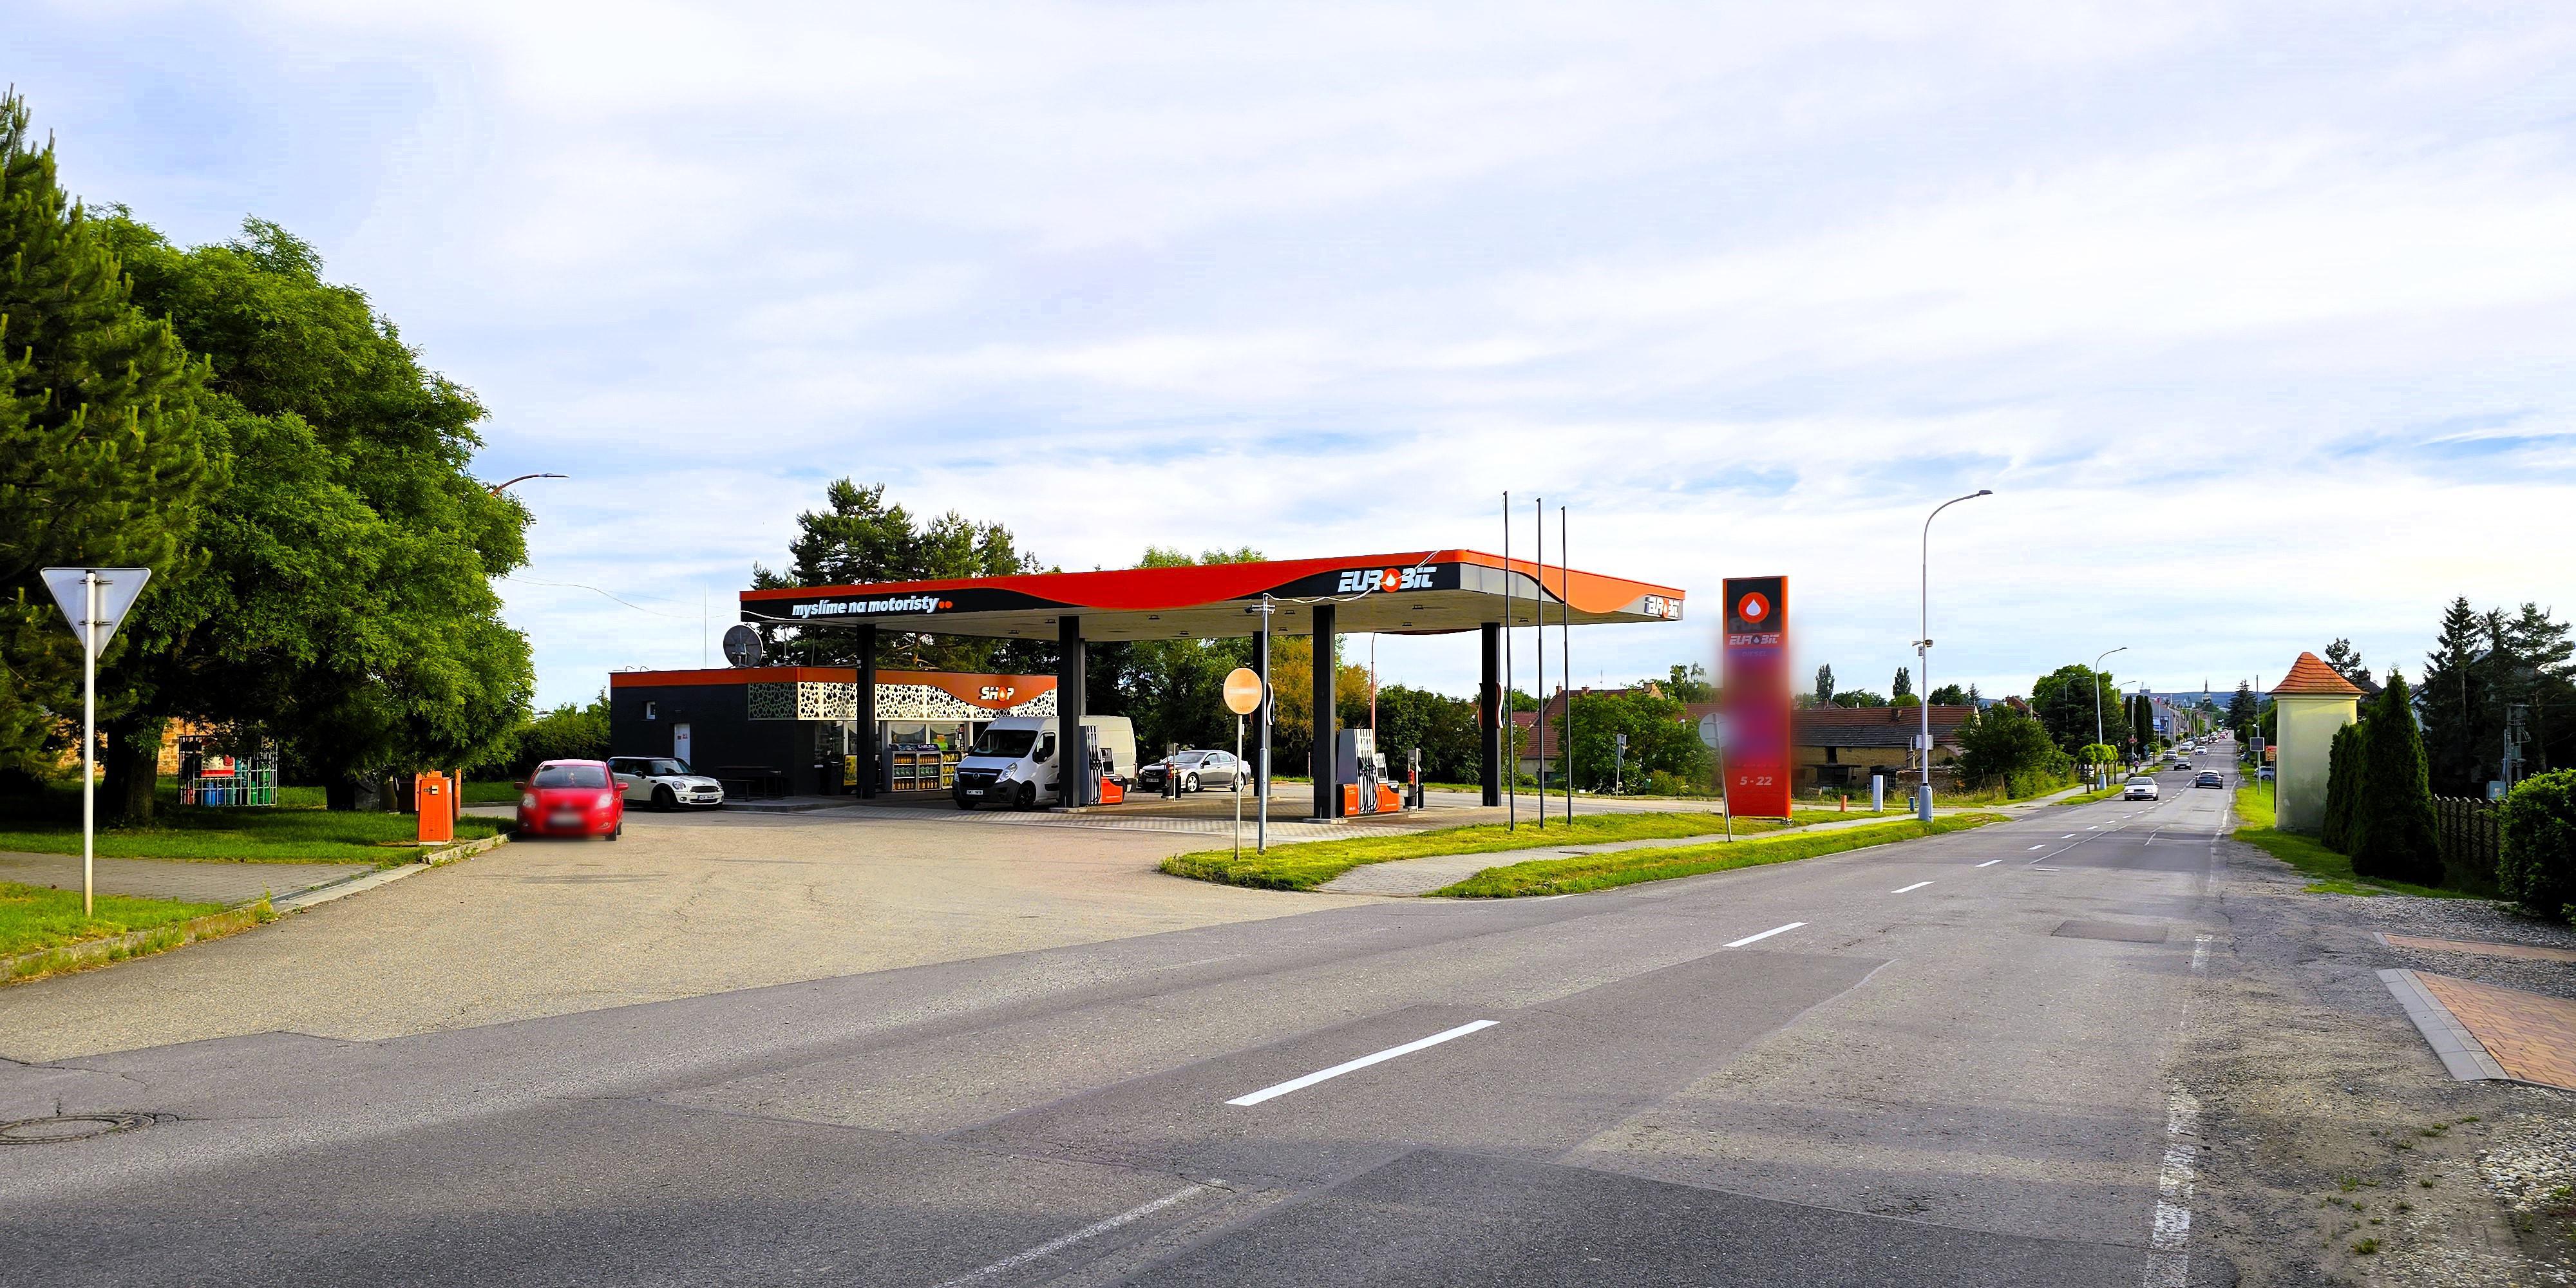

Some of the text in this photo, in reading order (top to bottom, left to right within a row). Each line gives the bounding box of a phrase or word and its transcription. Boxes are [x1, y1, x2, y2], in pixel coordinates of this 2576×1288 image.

[792, 596, 940, 618] myslíme na motoristy
[980, 687, 1014, 701] SHOP
[1739, 776, 1748, 786] 5
[1756, 776, 1773, 786] 22
